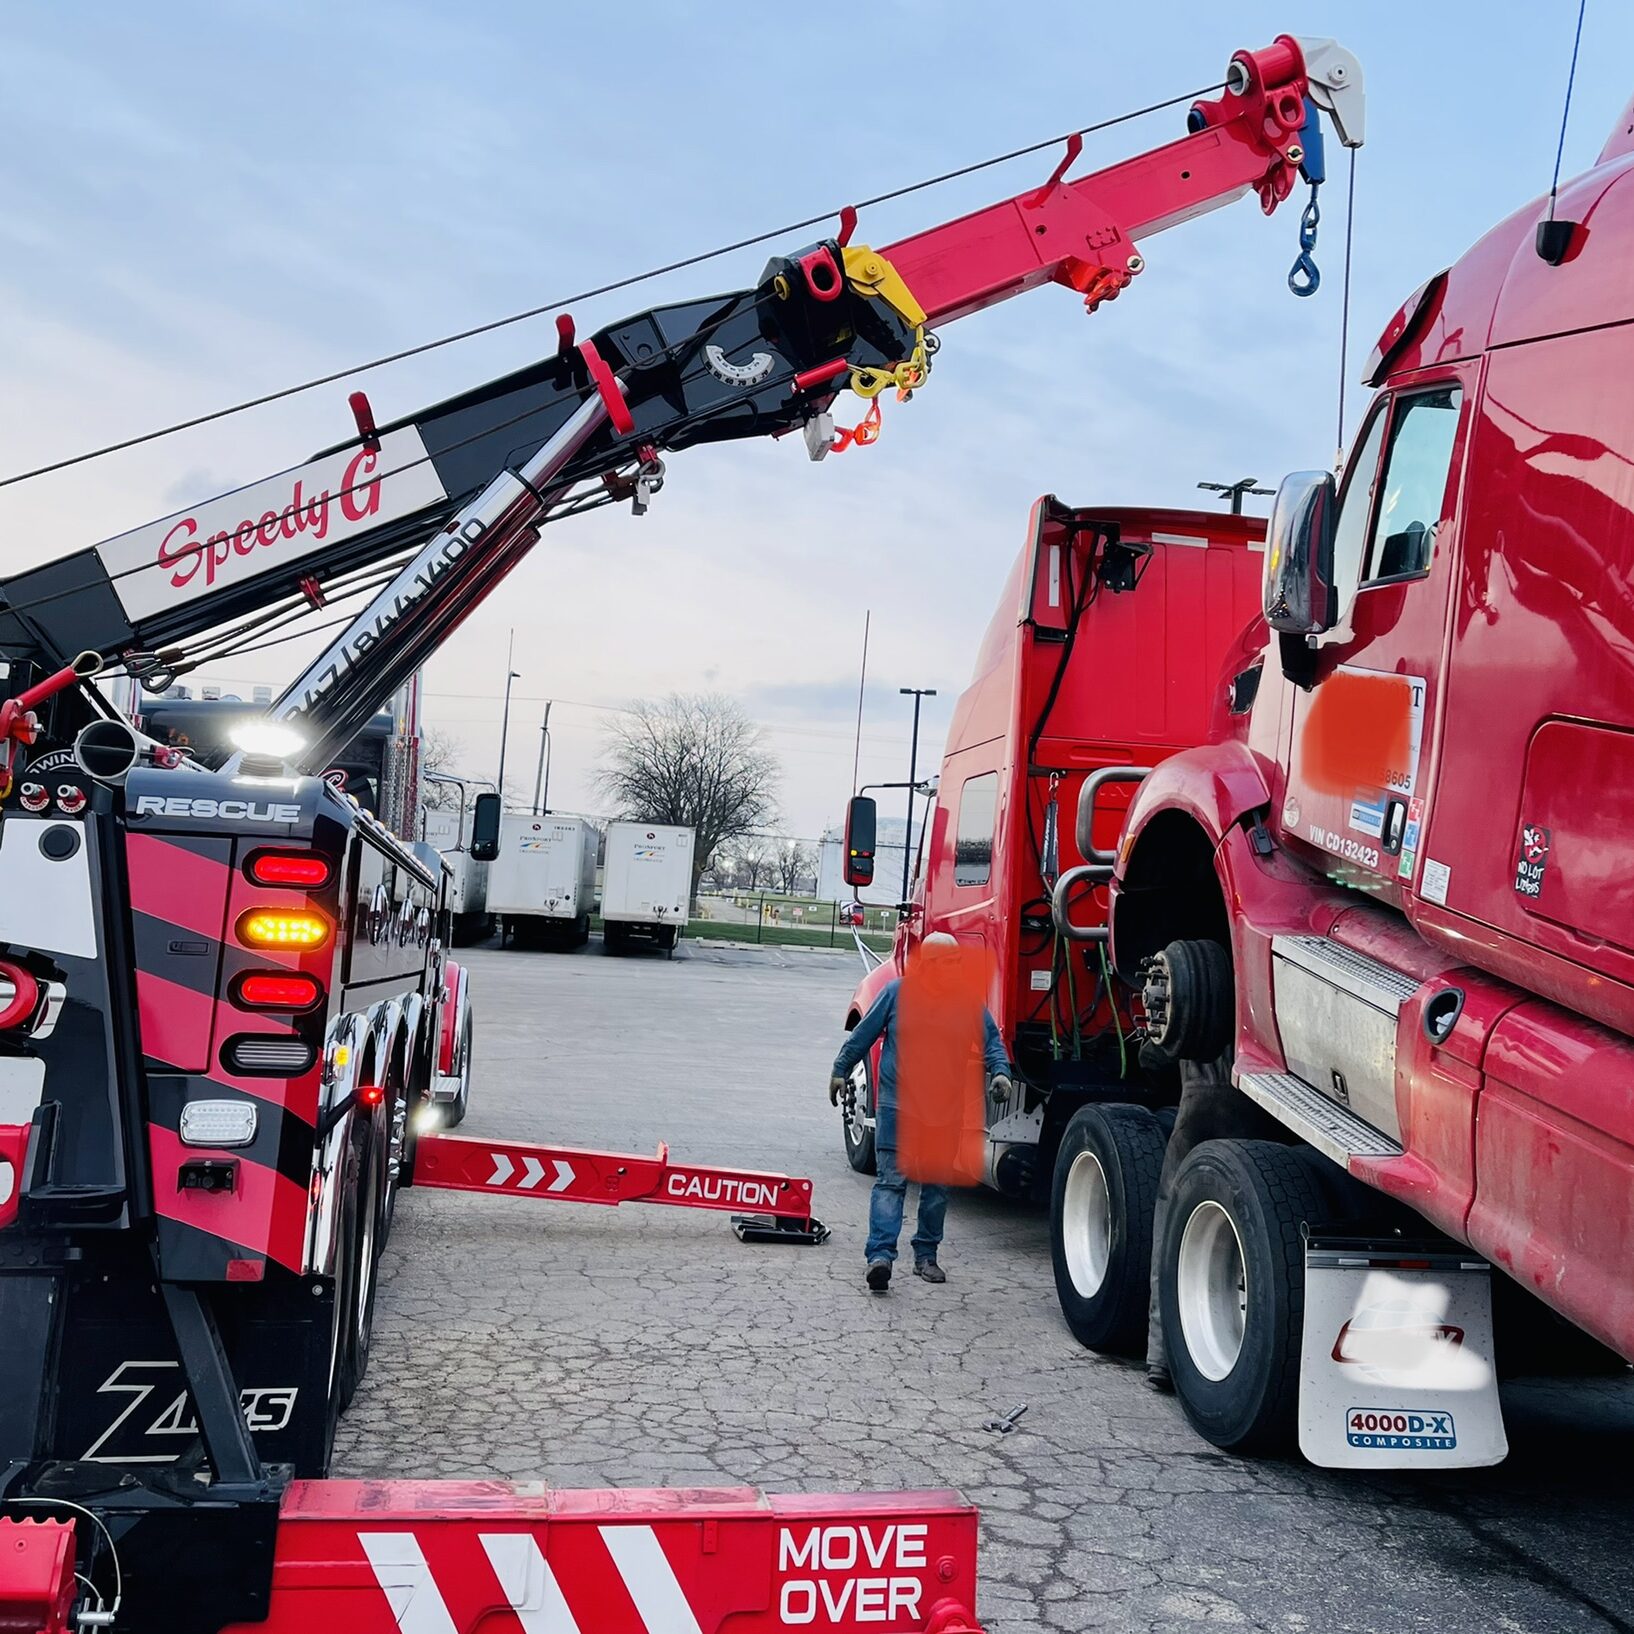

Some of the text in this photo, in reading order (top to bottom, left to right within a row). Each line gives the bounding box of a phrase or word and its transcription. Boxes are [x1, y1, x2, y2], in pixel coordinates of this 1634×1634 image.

[157, 448, 382, 588] Speedy G
[135, 796, 302, 823] RESCUE
[1309, 825, 1326, 845] VIN
[1326, 832, 1379, 868] CD132423
[1528, 864, 1544, 880] LOT
[667, 1173, 778, 1207] CAUTION
[1351, 1414, 1449, 1434] 4000D-X
[1352, 1435, 1452, 1448] COMPOSITE
[778, 1524, 928, 1571] MOVE
[779, 1577, 922, 1624] OVER
